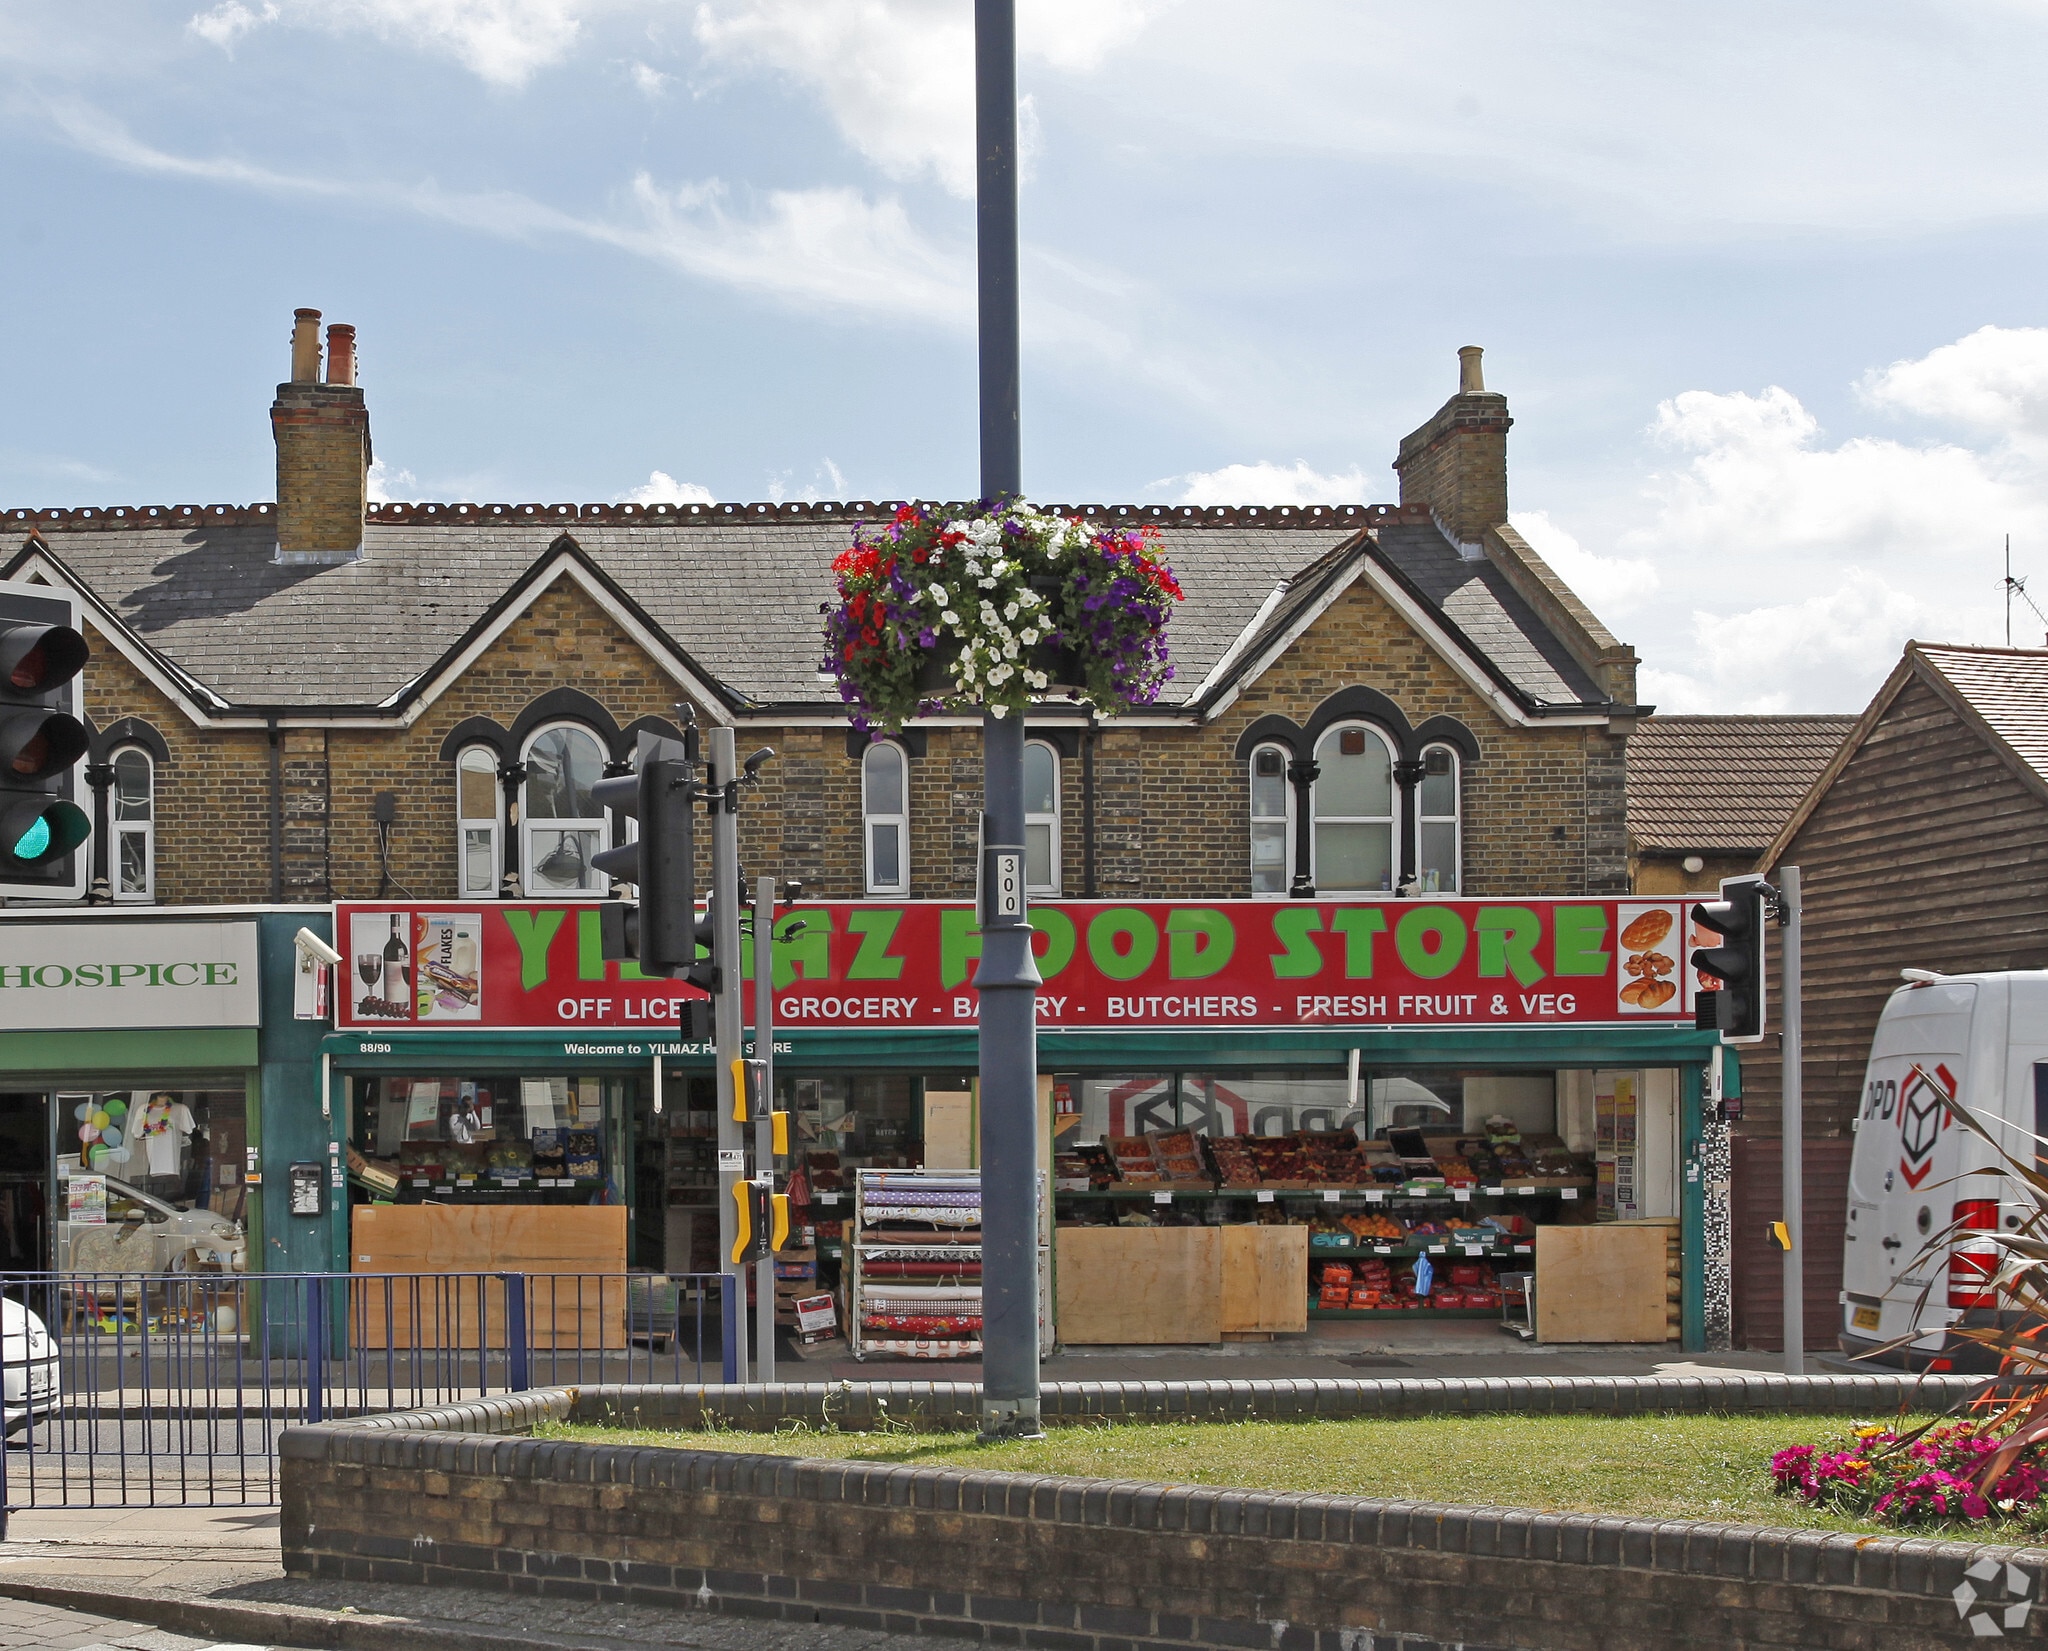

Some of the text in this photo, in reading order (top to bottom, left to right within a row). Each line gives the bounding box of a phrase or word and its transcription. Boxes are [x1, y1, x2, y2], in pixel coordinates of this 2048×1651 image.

[1003, 858, 1016, 911] 300
[441, 928, 453, 964] FLAKES
[502, 908, 906, 992] YIAZ
[1269, 905, 1611, 989] STORE
[0, 962, 238, 988] HOSPICE
[557, 998, 612, 1019] OFF
[780, 997, 918, 1019] GROCERY
[1107, 996, 1257, 1018] BUTCHERS
[1296, 995, 1387, 1017] FRESH
[1398, 995, 1477, 1016] FRUIT
[1489, 993, 1510, 1016] &
[1519, 993, 1577, 1015] VEG
[359, 1043, 391, 1053] 88/90
[564, 1043, 626, 1055] Welcome
[627, 1043, 642, 1055] to
[648, 1043, 699, 1055] YILMAZ
